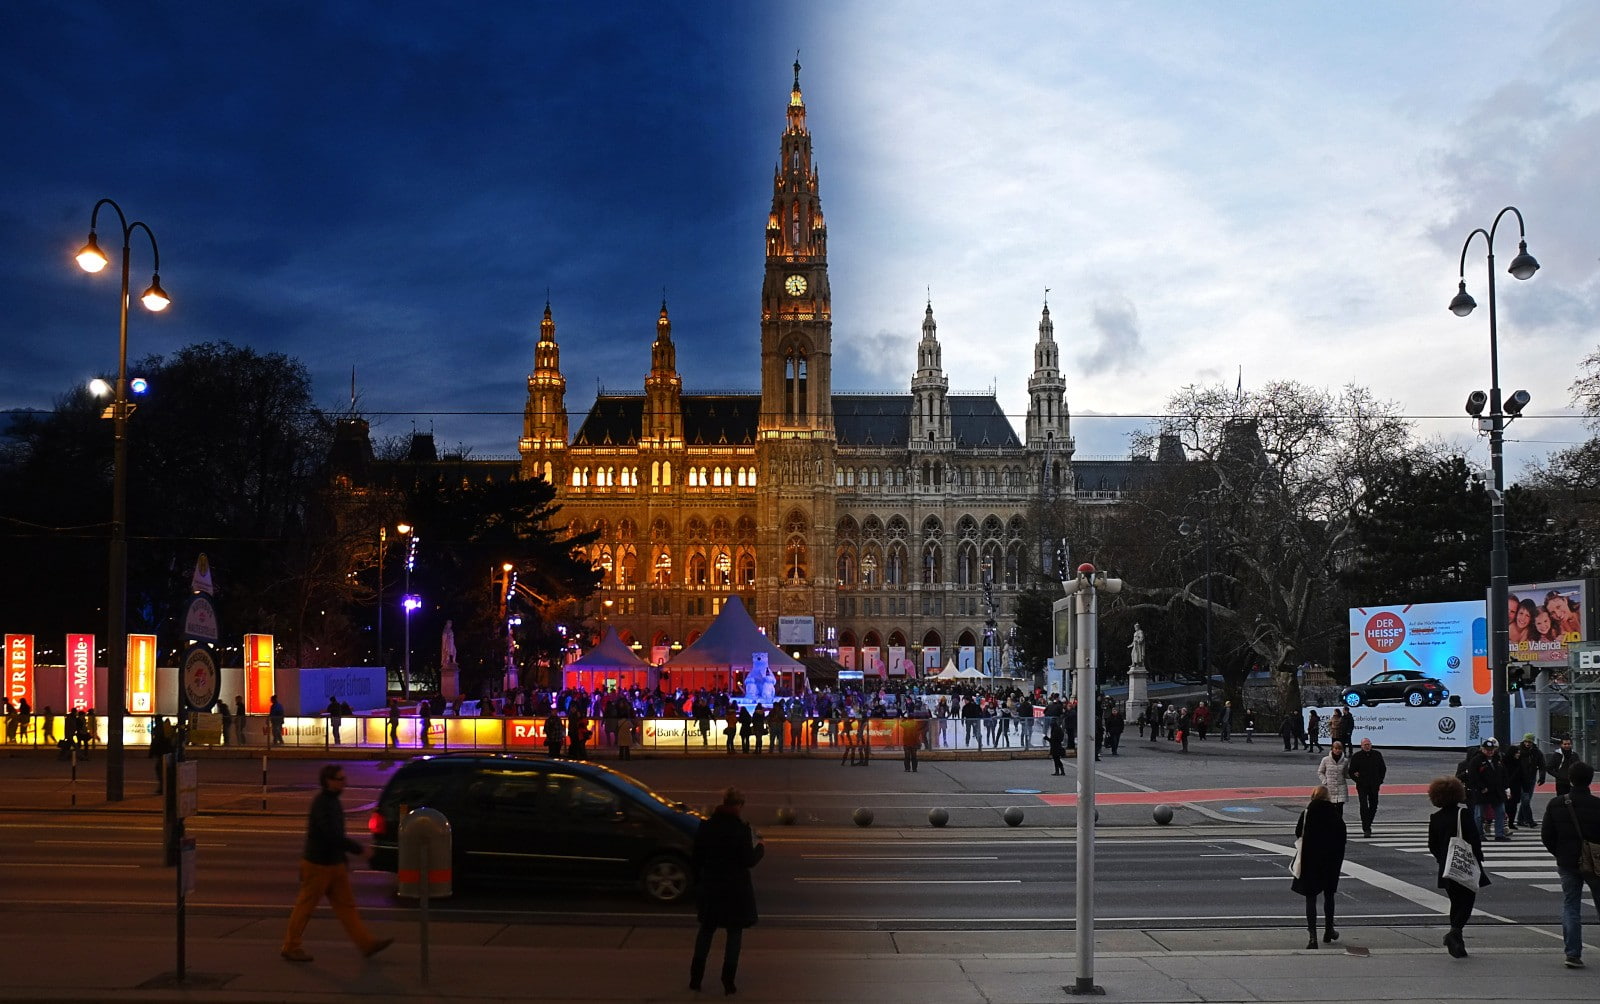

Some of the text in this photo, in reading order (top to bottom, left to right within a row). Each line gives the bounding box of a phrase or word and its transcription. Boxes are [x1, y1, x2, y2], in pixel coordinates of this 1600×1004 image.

[1376, 619, 1394, 628] DER
[1376, 639, 1394, 648] TIPP
[1529, 640, 1561, 651] Valencia
[657, 728, 711, 737] Bank Austa
